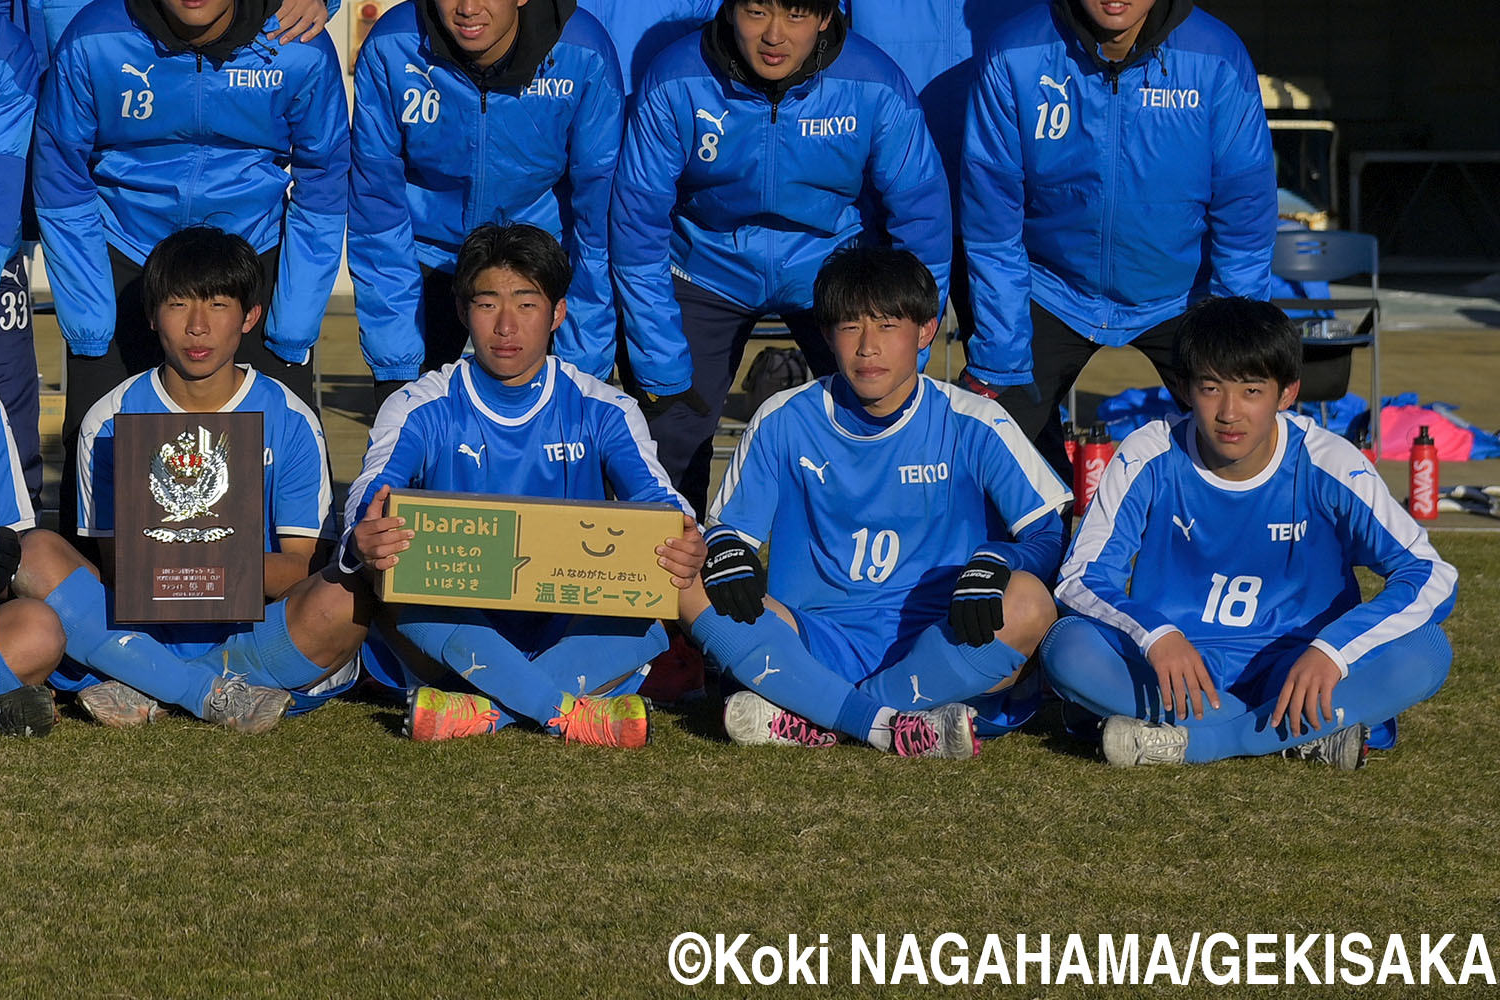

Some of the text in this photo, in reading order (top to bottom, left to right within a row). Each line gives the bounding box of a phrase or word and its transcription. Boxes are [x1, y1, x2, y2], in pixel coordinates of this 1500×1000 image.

[225, 68, 283, 89] TEIKYO
[521, 76, 574, 97] EIKYO
[121, 89, 154, 120] 13
[402, 88, 441, 124] 26
[1138, 87, 1199, 109] TEIKYO
[798, 116, 857, 137] TEIKYO
[1034, 100, 1071, 140] 19
[697, 133, 718, 162] 8
[0, 290, 29, 331] 33
[543, 441, 585, 462] TEYO
[1413, 458, 1434, 515] SAVAS
[414, 511, 499, 537] Ibaraki
[426, 544, 482, 557] いいもの
[849, 527, 900, 583] 19
[424, 577, 480, 592] いばらき
[550, 567, 647, 583] JA なめがたしおさい
[534, 581, 664, 609] 温室ピーマン
[1201, 572, 1262, 627] 18
